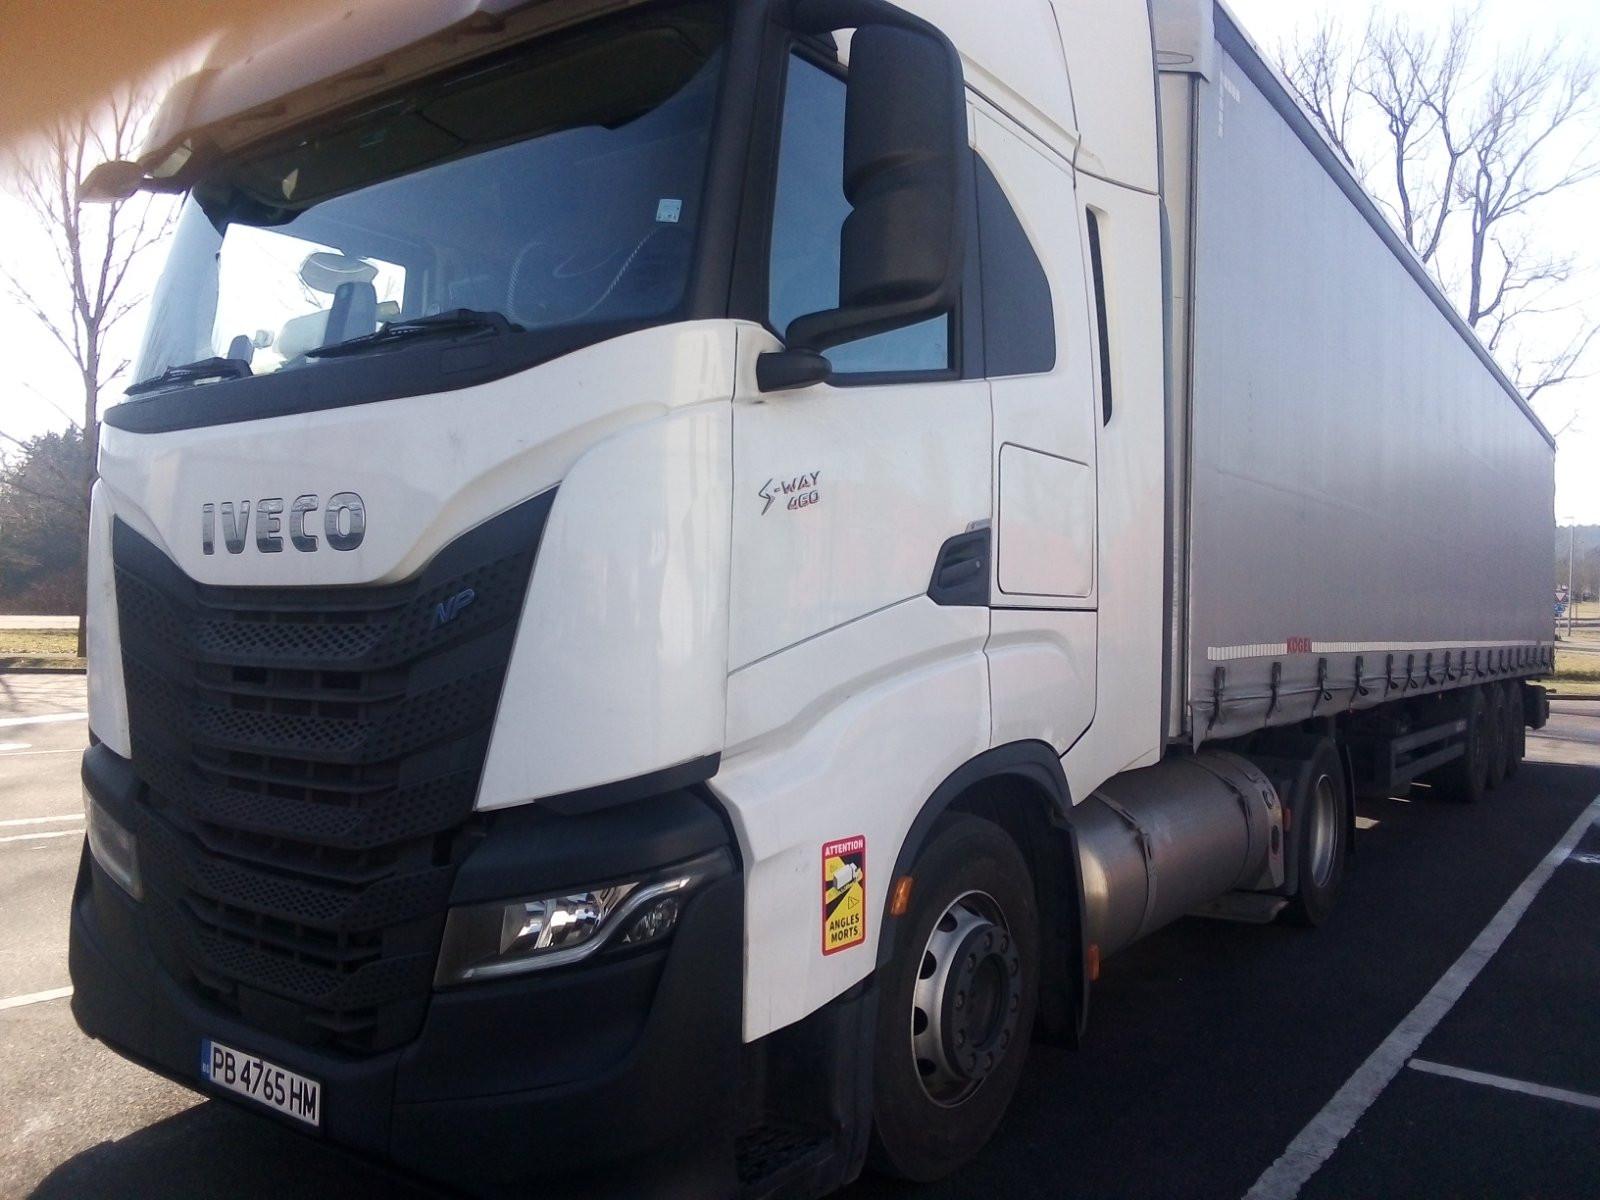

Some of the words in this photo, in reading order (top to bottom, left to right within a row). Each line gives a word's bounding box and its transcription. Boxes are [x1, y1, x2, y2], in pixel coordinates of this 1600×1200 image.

[758, 470, 821, 516] S-WAY
[787, 490, 819, 510] 460
[202, 491, 366, 555] IVECO
[825, 839, 864, 857] ATTENTION
[829, 913, 860, 931] ANGLES
[830, 925, 859, 943] MORTS
[213, 1046, 236, 1085] PB
[240, 1060, 285, 1106] 4765
[289, 1077, 317, 1121] HM
